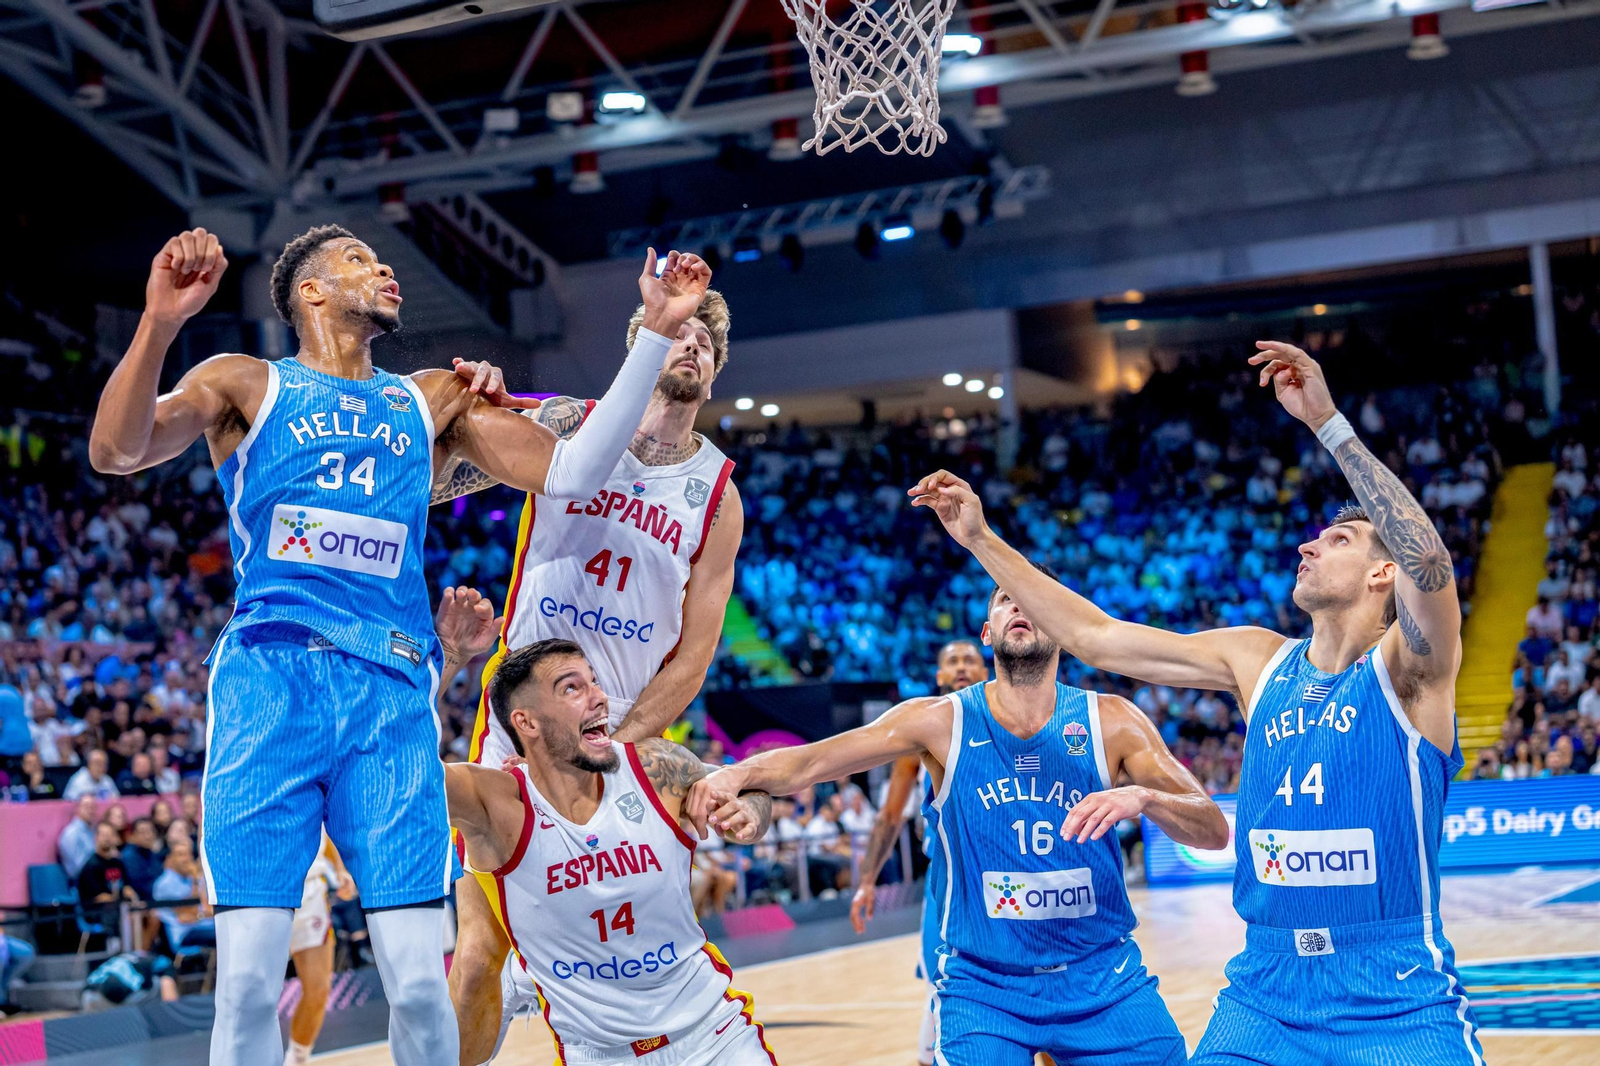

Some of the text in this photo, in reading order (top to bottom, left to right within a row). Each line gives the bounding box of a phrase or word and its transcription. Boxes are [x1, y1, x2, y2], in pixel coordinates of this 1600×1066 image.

[288, 411, 412, 456] HELLAS
[316, 451, 376, 496] 34
[585, 548, 633, 592] 41
[540, 596, 654, 643] endesa
[1264, 701, 1357, 748] HELAS
[976, 777, 1084, 812] HELLAS
[1274, 762, 1325, 807] 44
[1011, 819, 1054, 856] 16
[1492, 807, 1566, 837] Dairy
[547, 840, 662, 895] ESPAÑA
[589, 901, 635, 943] 14
[552, 941, 679, 980] endesa
